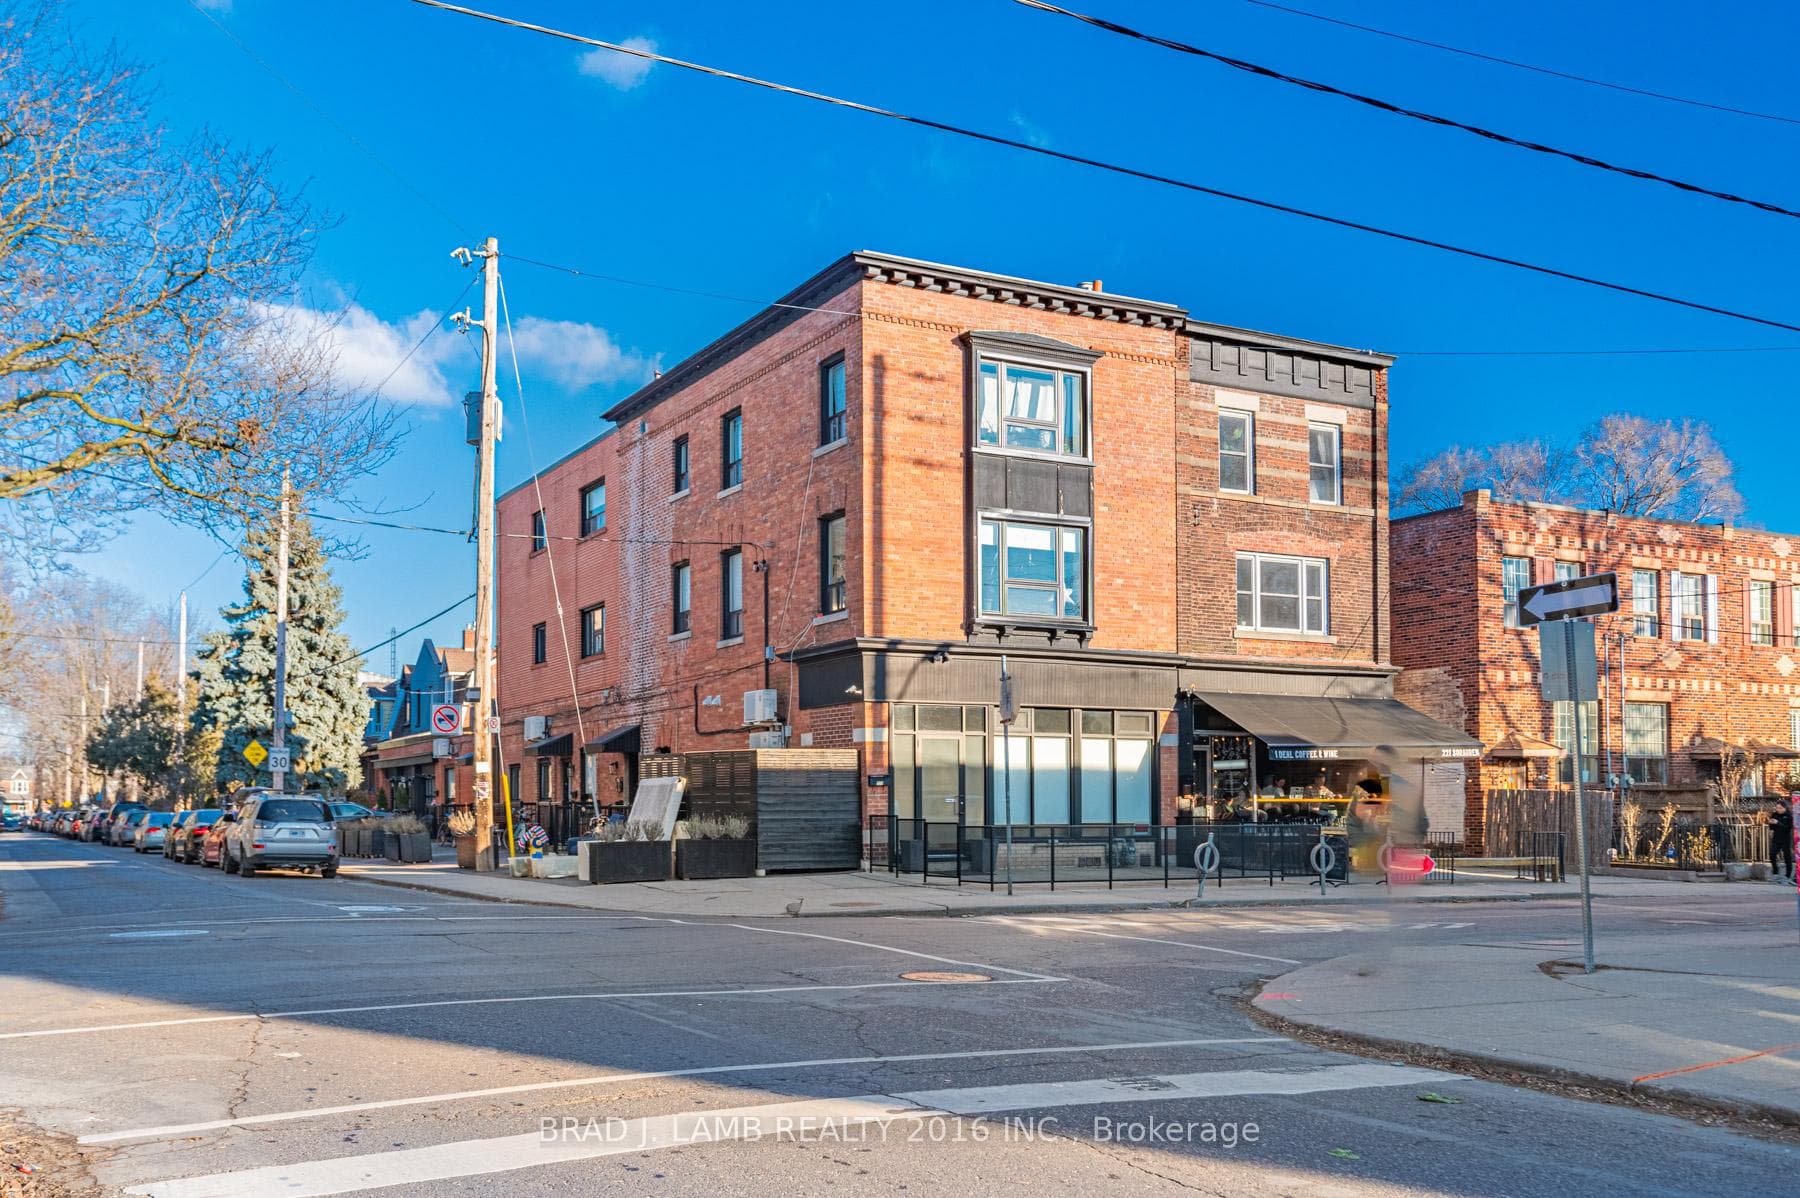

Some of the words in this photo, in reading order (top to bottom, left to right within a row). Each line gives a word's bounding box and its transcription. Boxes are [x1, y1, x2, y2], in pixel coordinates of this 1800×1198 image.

[1295, 750, 1317, 758] COFFEE
[1323, 749, 1339, 758] WINE
[272, 757, 288, 768] 30
